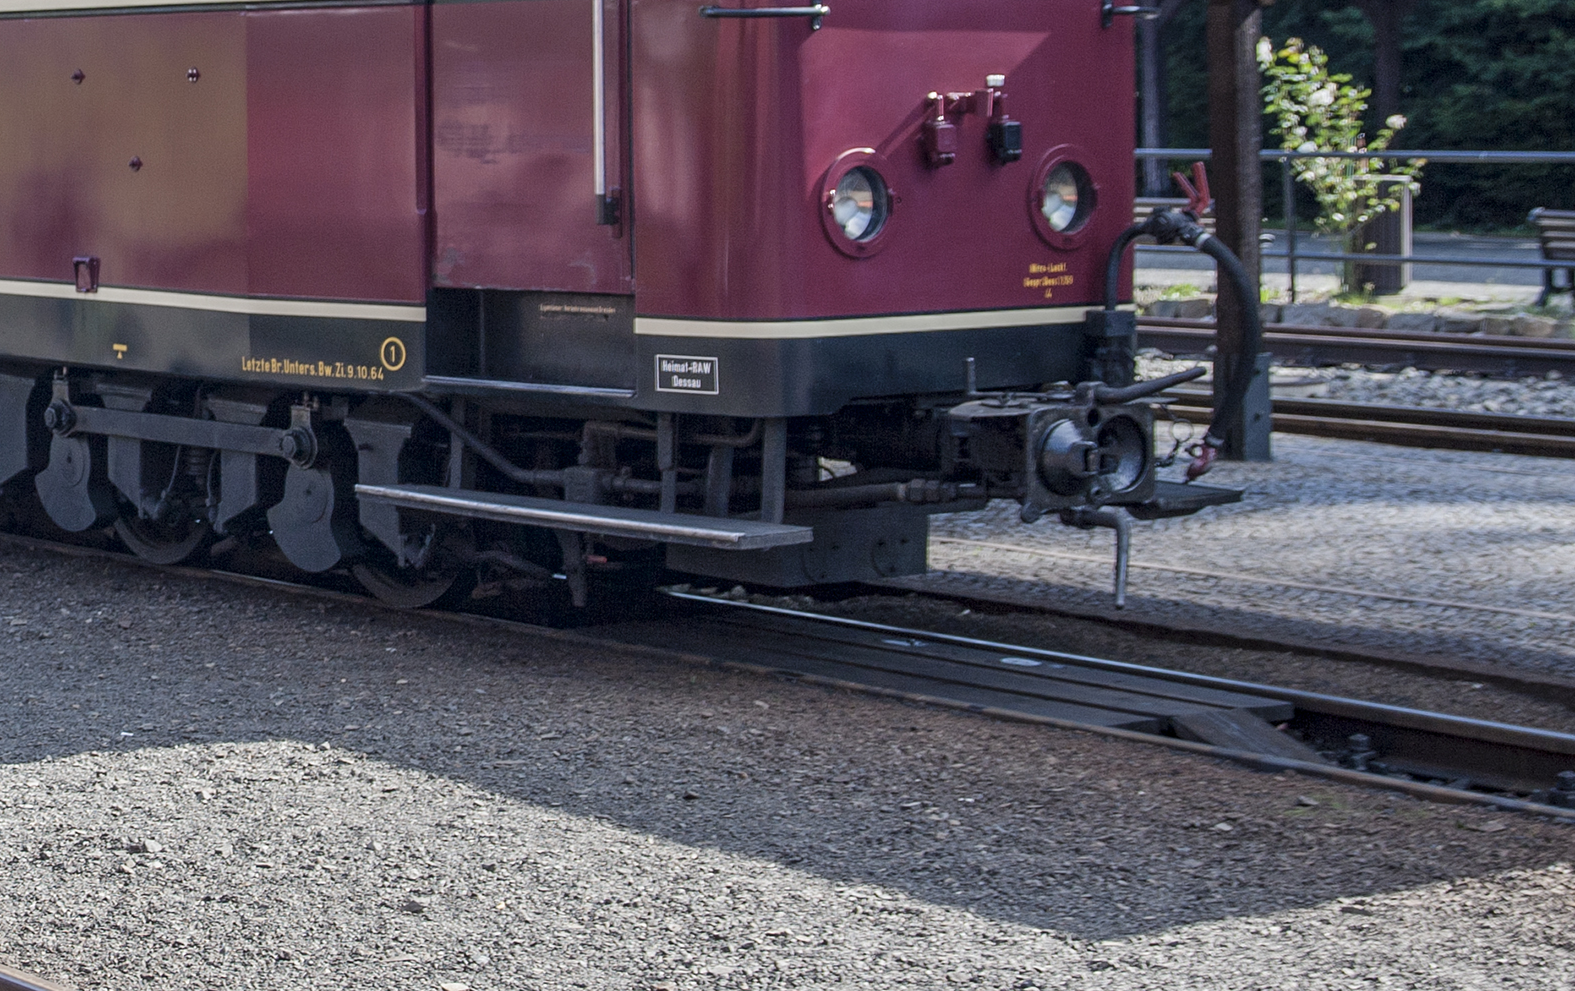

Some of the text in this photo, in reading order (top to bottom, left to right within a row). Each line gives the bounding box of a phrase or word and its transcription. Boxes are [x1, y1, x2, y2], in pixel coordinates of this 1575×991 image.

[241, 356, 270, 373] Letzte
[661, 359, 712, 374] Heimat-RAW
[672, 374, 701, 388] Dessau
